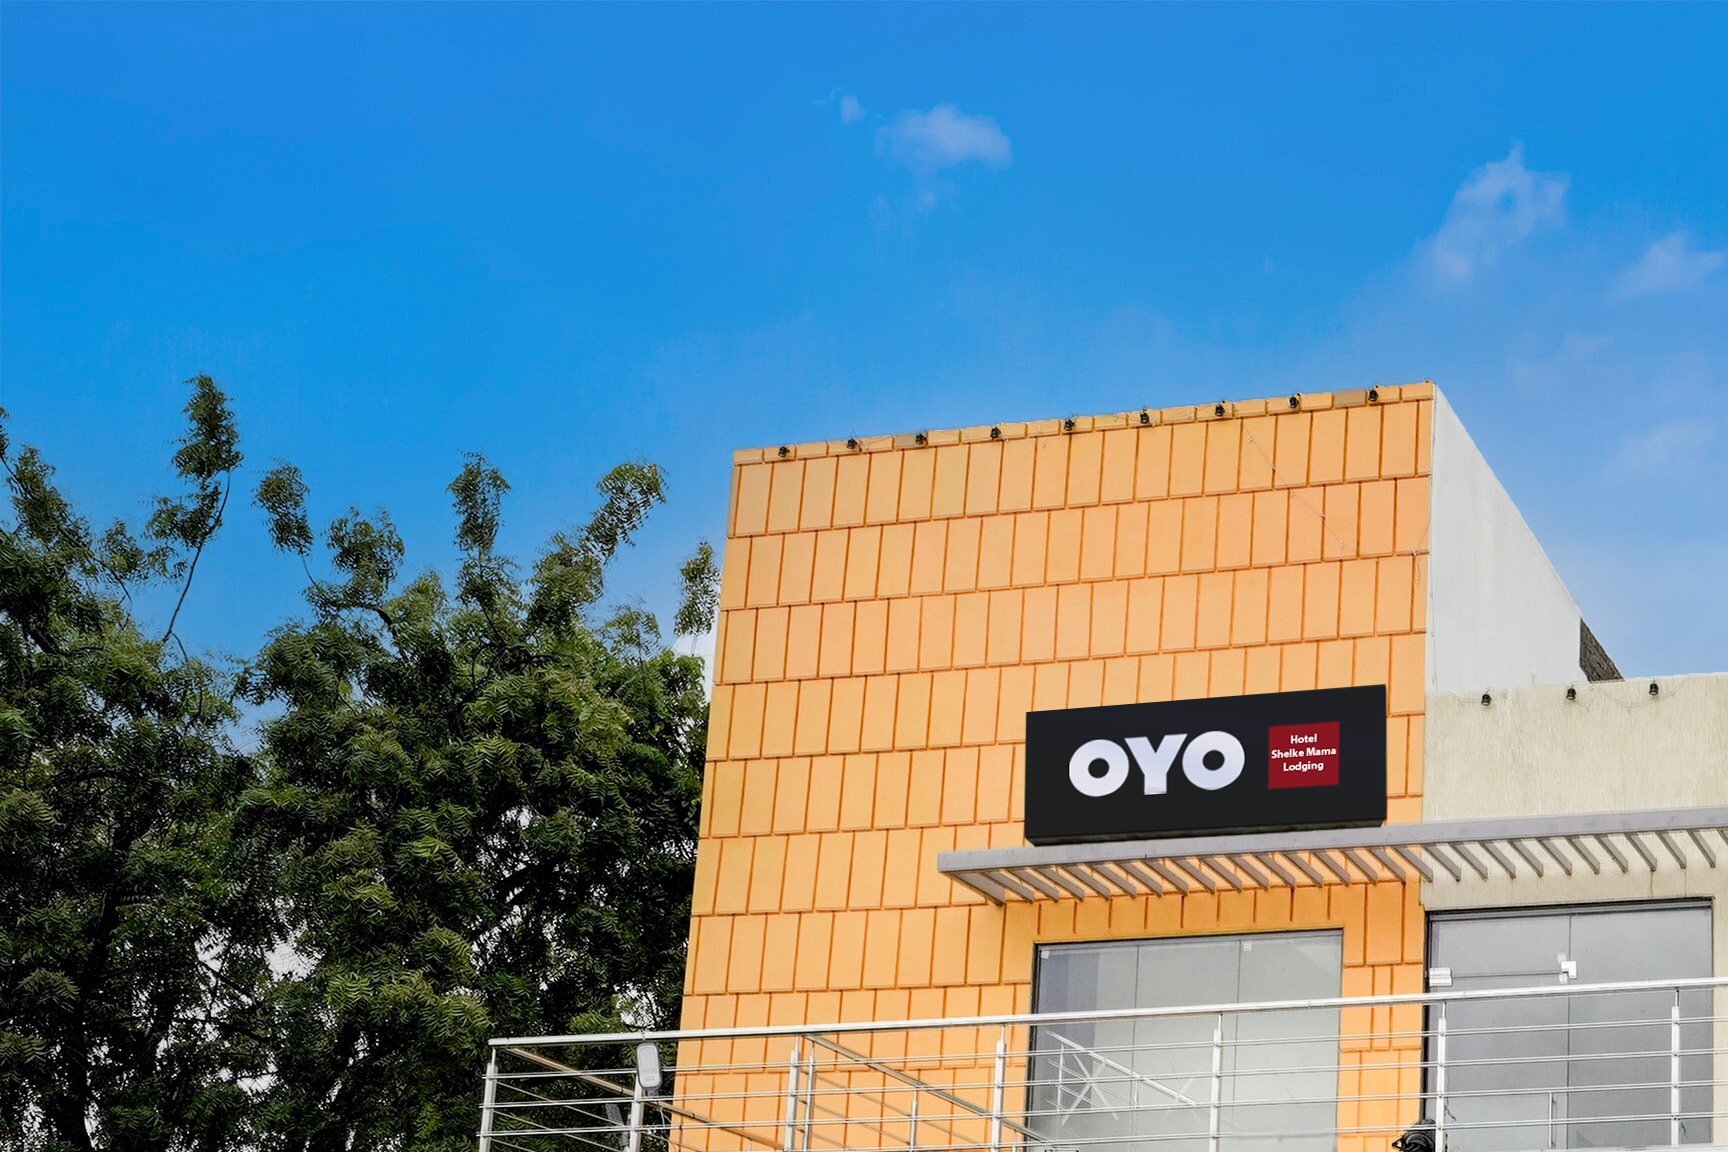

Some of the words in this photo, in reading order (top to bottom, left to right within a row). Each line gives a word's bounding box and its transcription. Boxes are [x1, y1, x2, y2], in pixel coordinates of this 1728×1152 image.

[1290, 733, 1318, 744] Hotel
[1271, 748, 1304, 759] Shelke
[1306, 747, 1337, 757] Mama
[1068, 730, 1246, 798] OYO
[1283, 761, 1324, 772] Lodging
